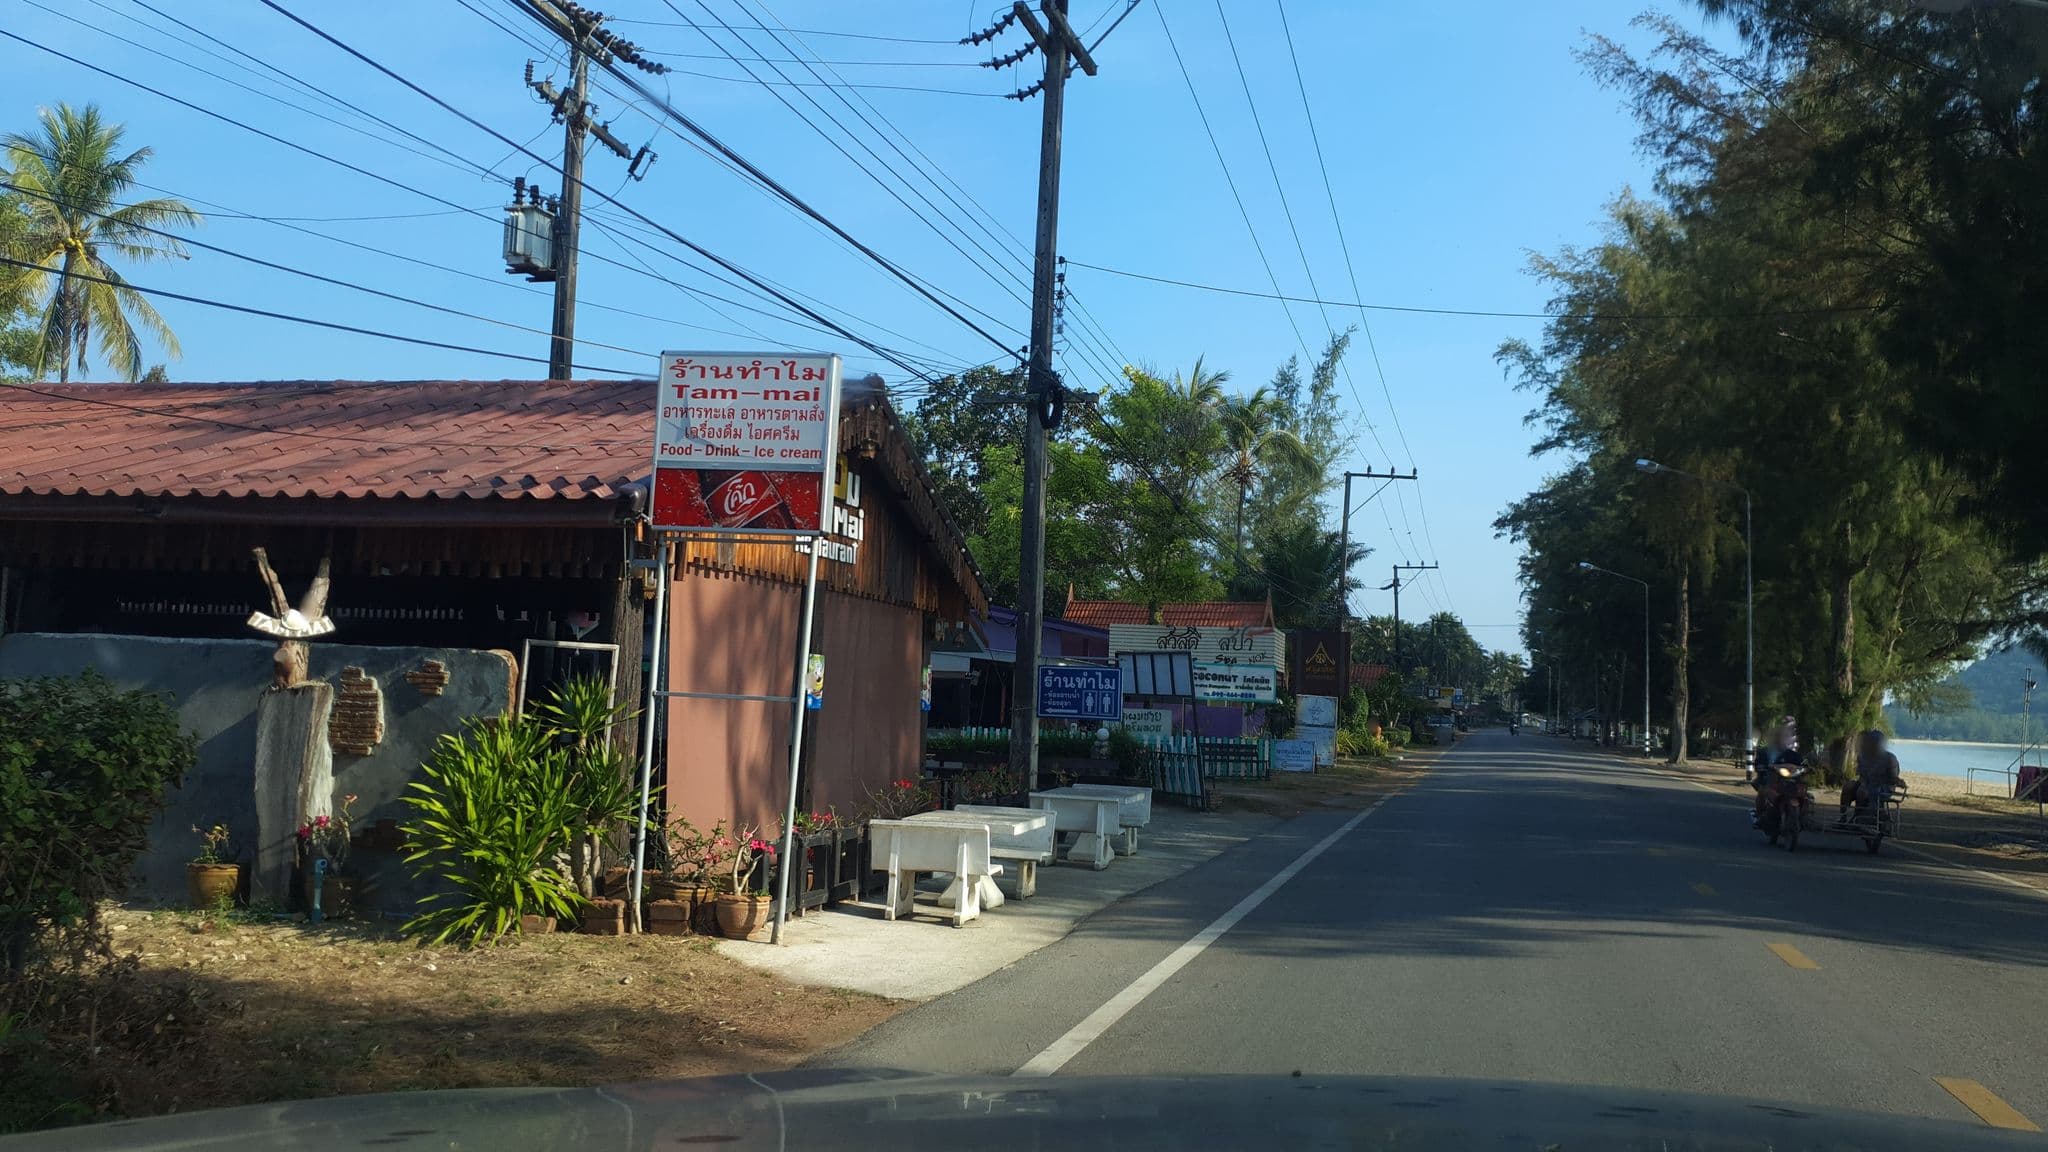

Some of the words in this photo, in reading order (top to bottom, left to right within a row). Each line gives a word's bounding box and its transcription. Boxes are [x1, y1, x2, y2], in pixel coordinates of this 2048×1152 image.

[669, 358, 827, 381] ร้านทำไม
[663, 406, 736, 419] อาหารทะเล
[740, 404, 825, 422] อาหารตามสั่ง
[684, 418, 742, 440] เครื่องดื่ม
[754, 446, 775, 458] Ice
[780, 448, 823, 459] cream
[833, 506, 865, 541] Mai
[795, 535, 859, 565] Retaurant
[1043, 670, 1116, 690] ร้านทำไม
